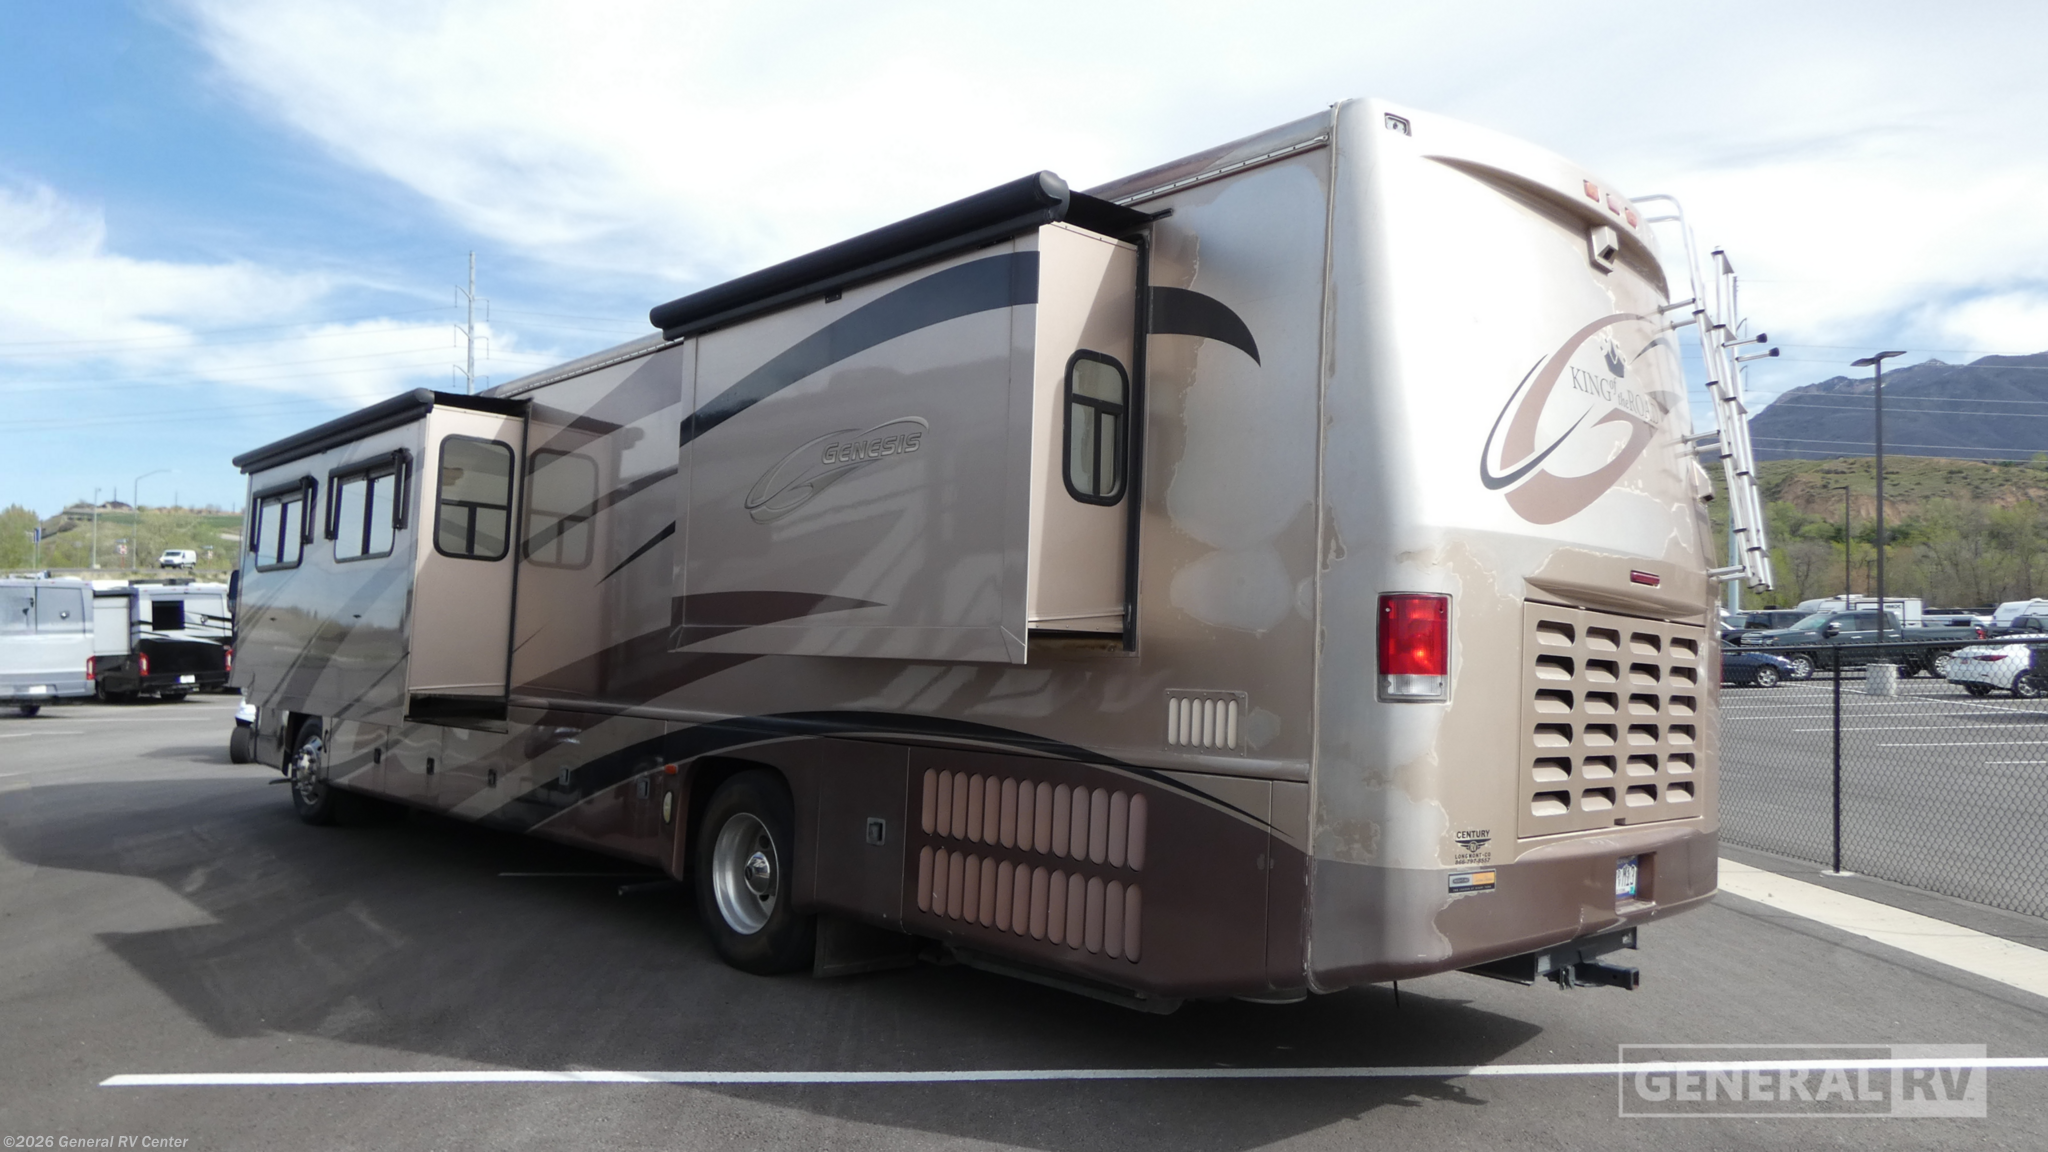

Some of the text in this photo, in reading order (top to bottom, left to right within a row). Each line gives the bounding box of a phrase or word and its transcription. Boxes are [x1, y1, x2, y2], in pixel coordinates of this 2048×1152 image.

[1570, 366, 1611, 402] KING
[1609, 377, 1617, 395] of
[821, 432, 922, 465] GENESIS
[1456, 830, 1490, 839] CENTURY
